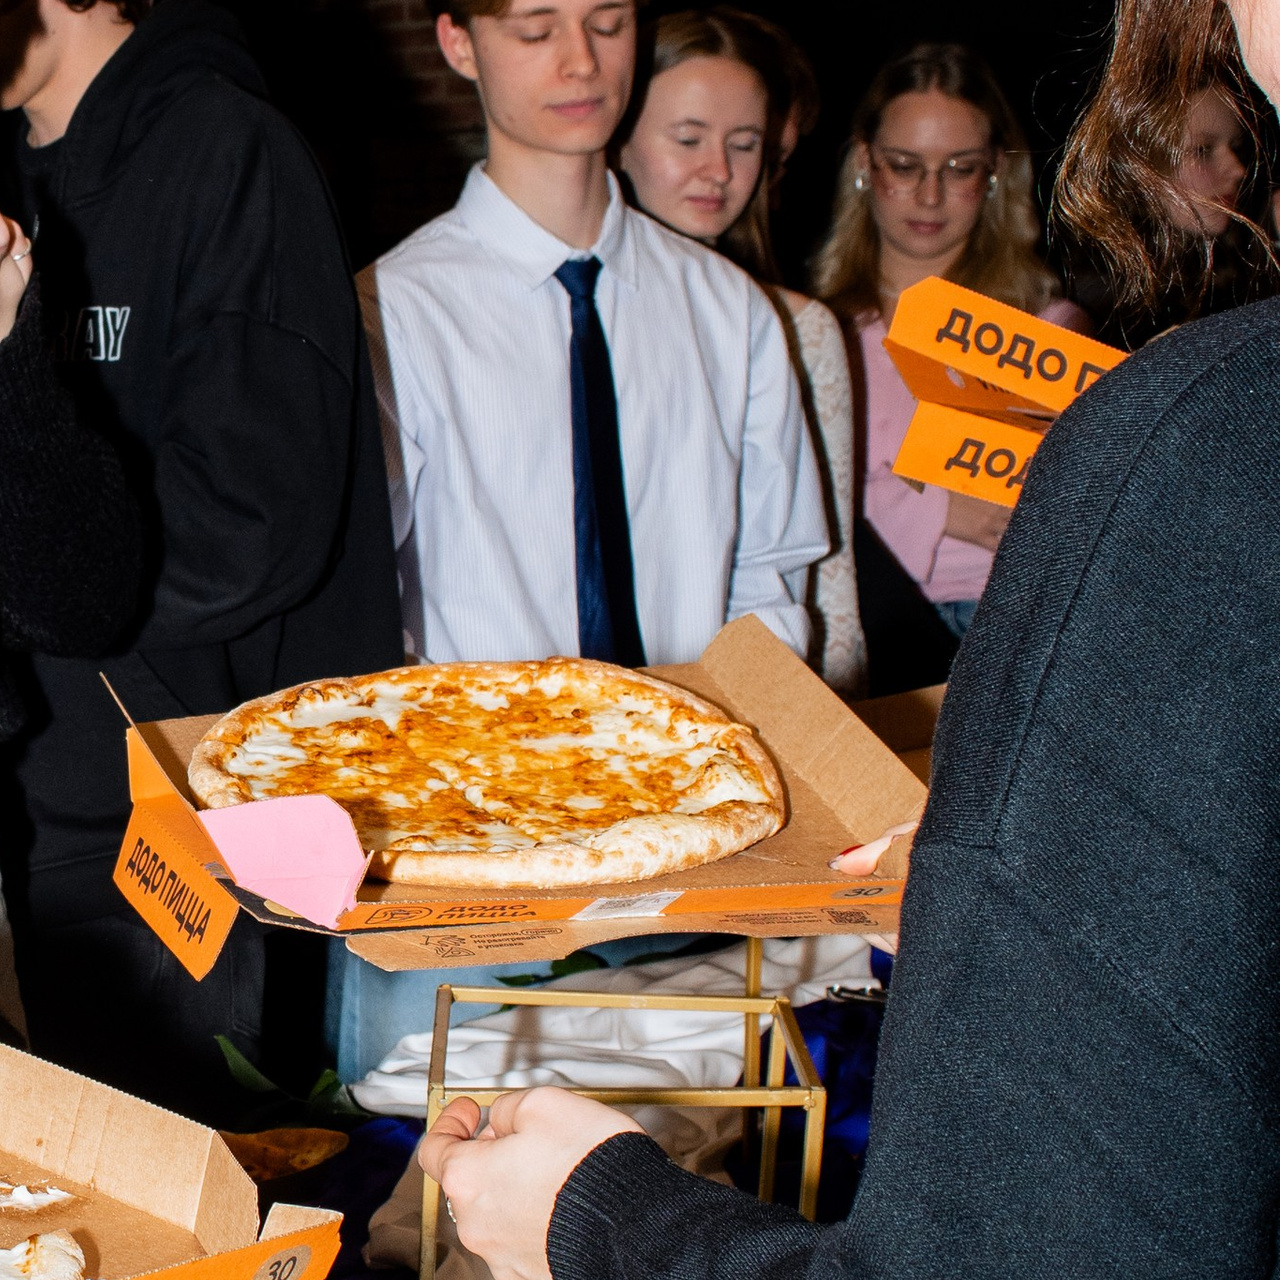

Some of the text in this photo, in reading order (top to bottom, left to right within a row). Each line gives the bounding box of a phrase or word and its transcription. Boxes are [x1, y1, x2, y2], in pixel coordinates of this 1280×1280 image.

[936, 308, 1068, 382] ДОДО
[944, 438, 1032, 489] ДО
[125, 836, 211, 944] ДОДО ПИЦЦА
[844, 887, 884, 897] 30
[436, 911, 537, 919] ПИЦЦА
[443, 904, 528, 914] ДОДО
